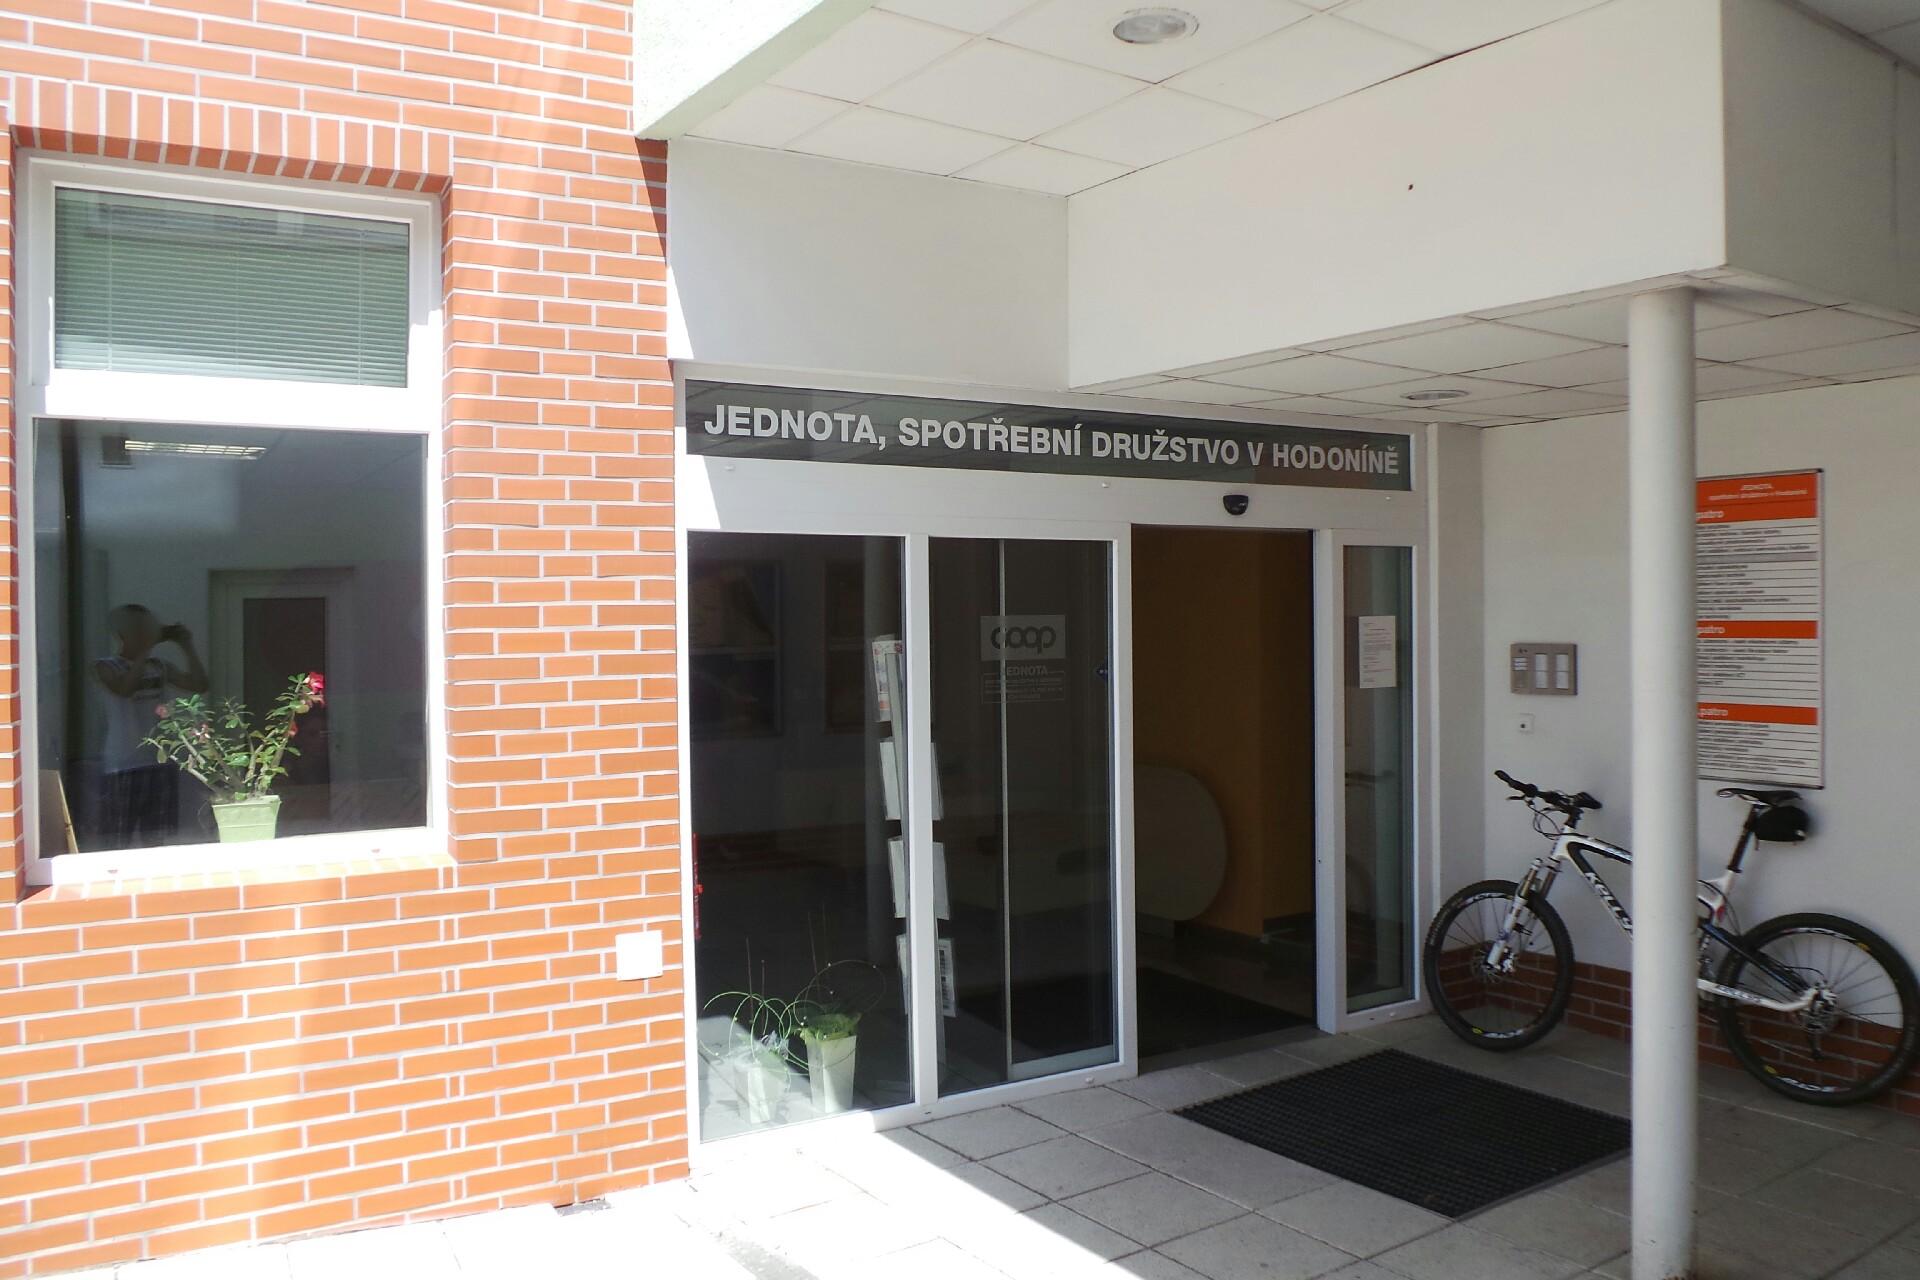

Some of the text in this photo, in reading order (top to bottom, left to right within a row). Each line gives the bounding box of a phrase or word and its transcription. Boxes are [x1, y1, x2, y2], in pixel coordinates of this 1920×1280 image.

[705, 405, 1400, 475] JEDNOTA, SPOTŘEBNÍ DRUŽSTVO V HODONÍNĚ
[990, 625, 1056, 655] coop
[1001, 664, 1048, 676] EDNOTA
